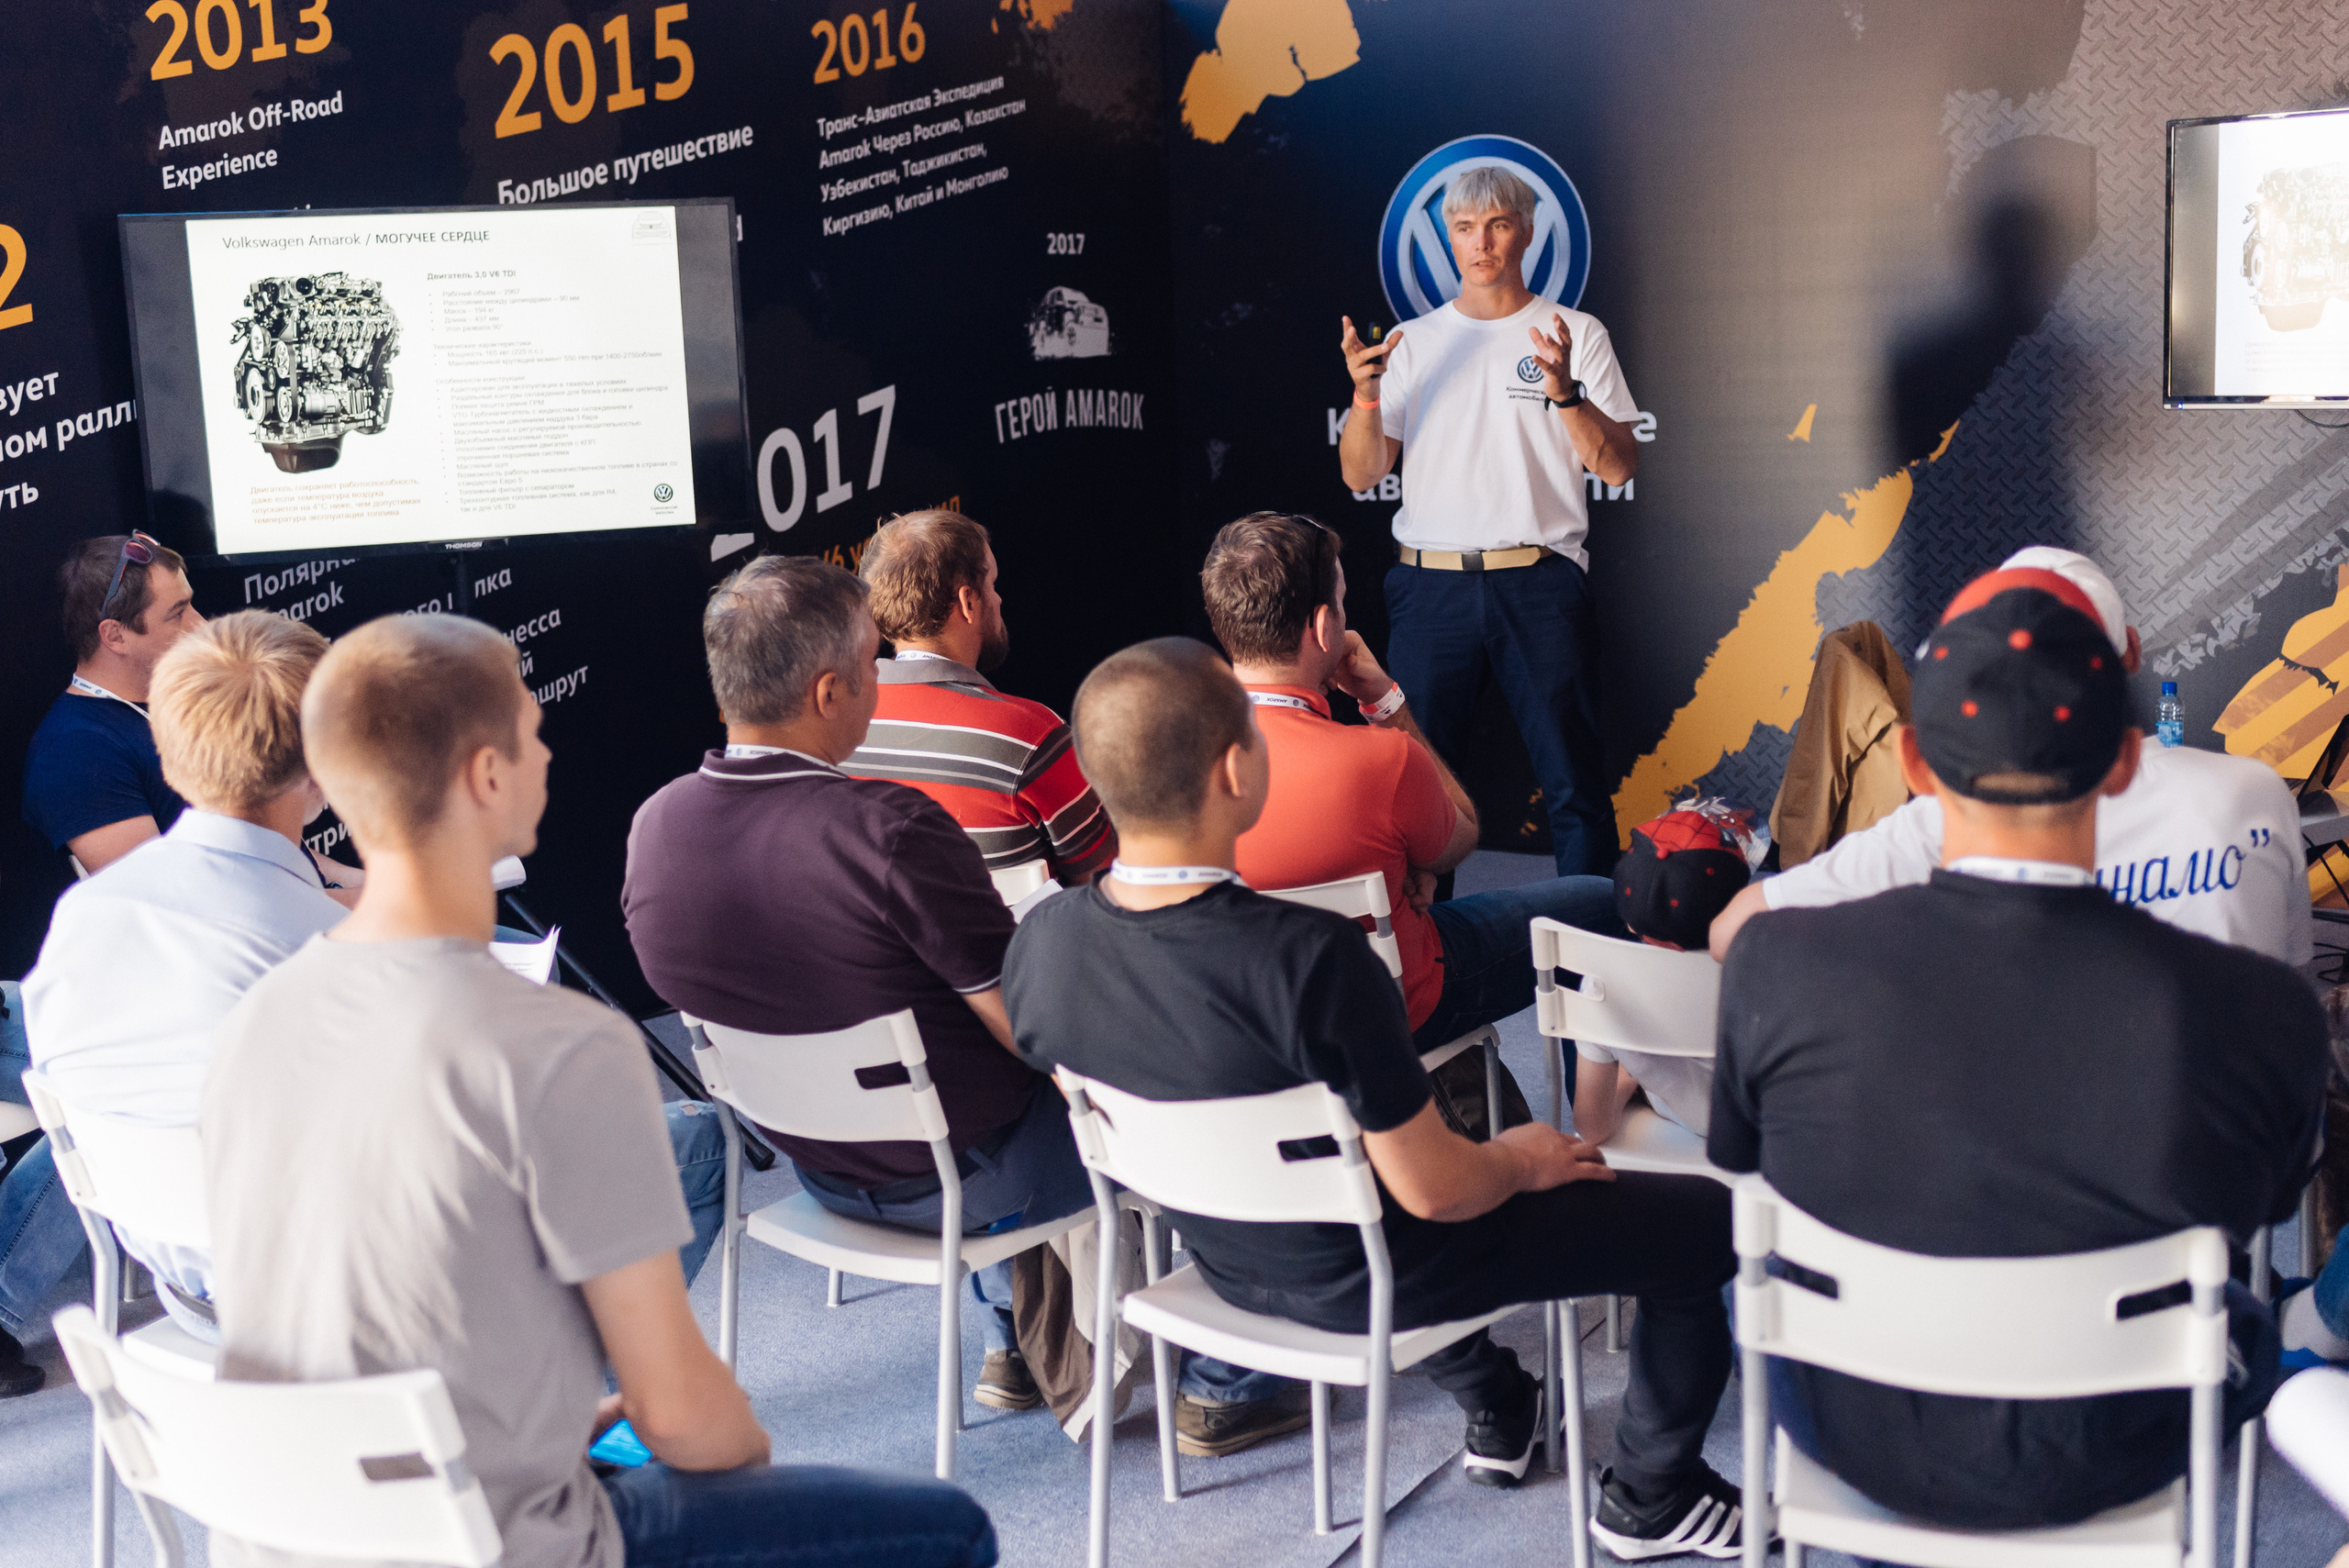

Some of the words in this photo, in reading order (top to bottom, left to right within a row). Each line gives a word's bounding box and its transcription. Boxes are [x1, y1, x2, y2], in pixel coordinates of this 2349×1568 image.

[145, 0, 333, 82] 2013
[811, 3, 926, 84] 2016
[489, 3, 695, 139] 2015
[933, 76, 1005, 107] Экспедиция
[159, 111, 245, 150] Amarok
[249, 91, 343, 131] Off-Road
[819, 139, 871, 170] Amarok
[873, 131, 912, 154] Через
[913, 117, 963, 141] Россию,
[965, 100, 1026, 128] Казахстан
[162, 148, 278, 190] Experience
[498, 163, 608, 204] Большое
[614, 126, 753, 184] путешествие
[820, 168, 900, 203] Узбекистан,
[902, 144, 987, 178] Таджикистан,
[823, 201, 893, 237] Киргизию,
[896, 184, 934, 213] Китай
[935, 185, 944, 202] и
[946, 167, 1008, 196] Монголию
[222, 235, 304, 252] Volkswagen
[307, 233, 361, 247] Amarok
[375, 230, 436, 245] МОГУЧЕЕ
[440, 228, 489, 243] СЕРДЦЕ
[1047, 232, 1085, 256] 2017
[426, 272, 473, 280] Двигатель
[995, 385, 1058, 444] ГЕРОЙ
[1065, 389, 1144, 429] AMAROK
[445, 540, 483, 550] THOMSON
